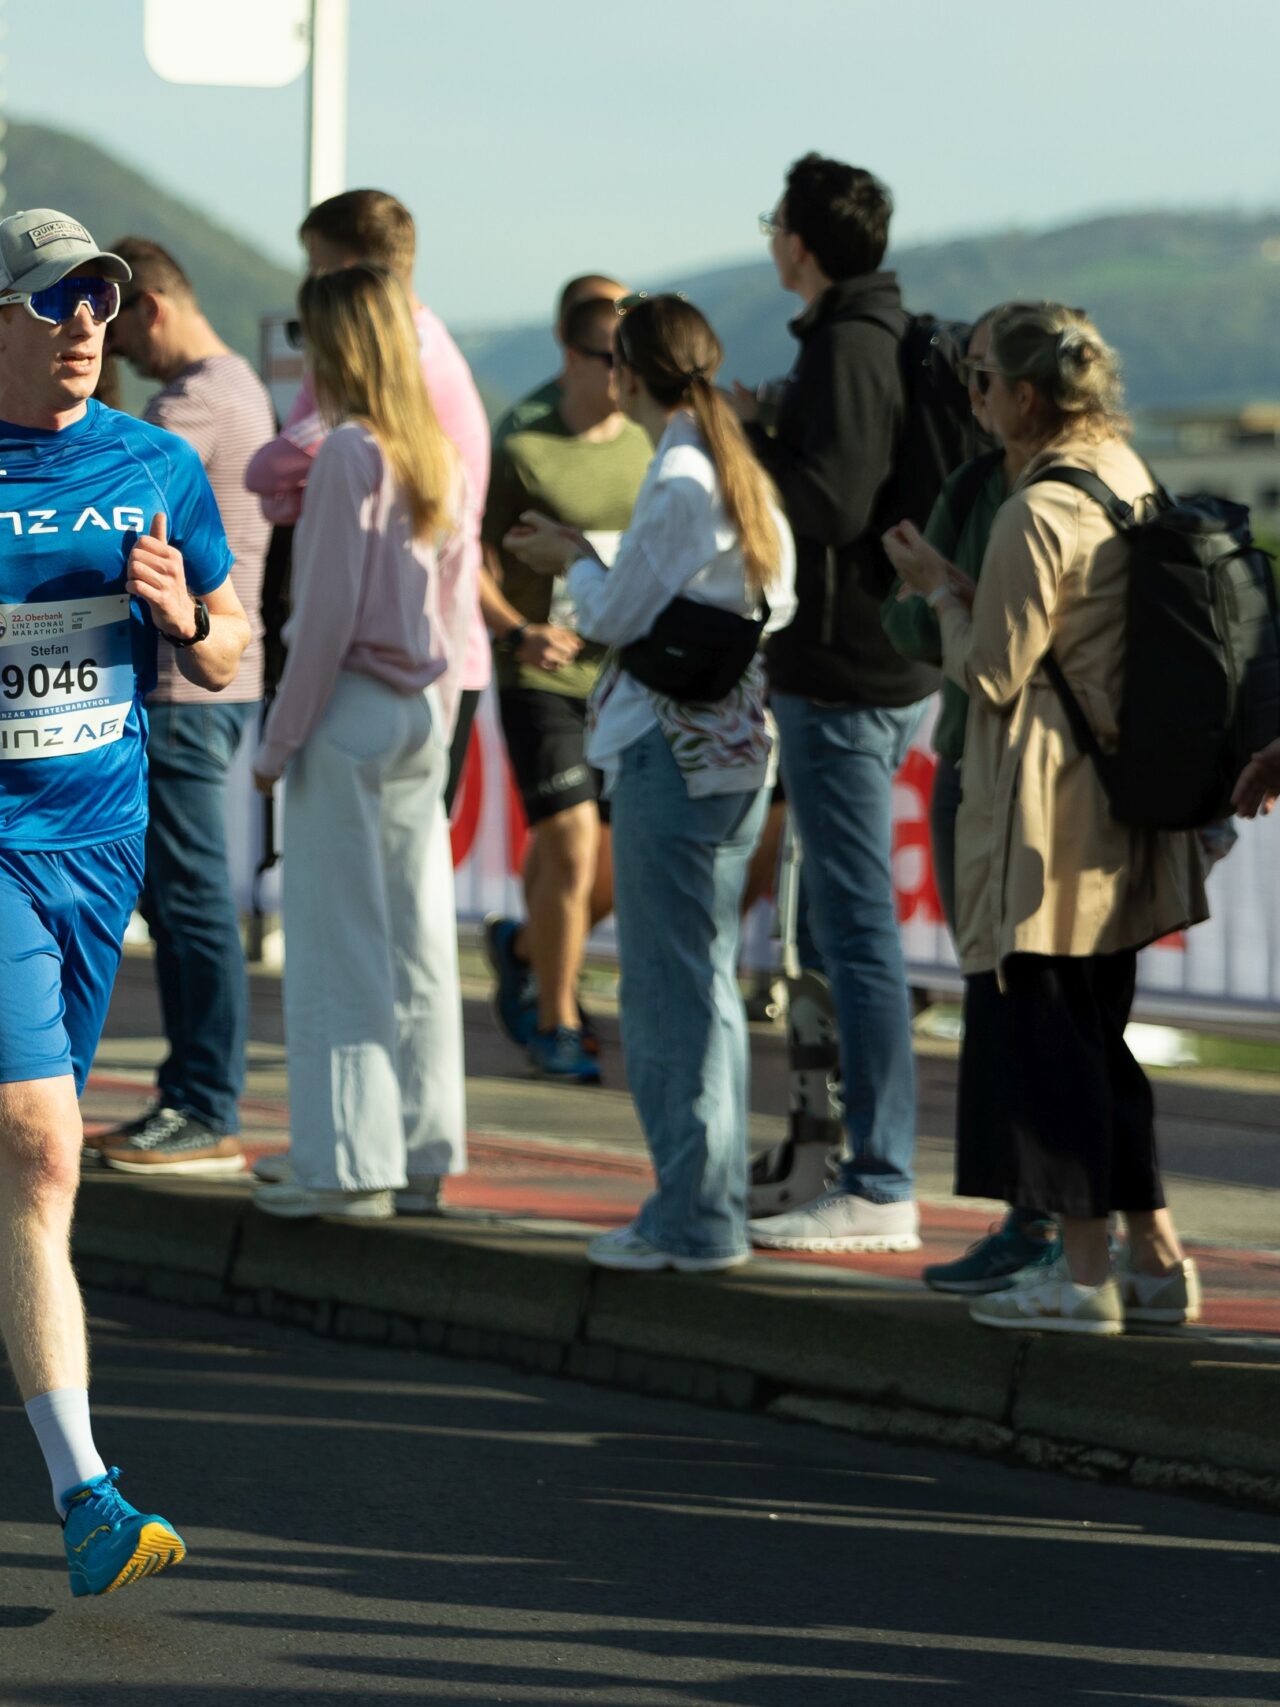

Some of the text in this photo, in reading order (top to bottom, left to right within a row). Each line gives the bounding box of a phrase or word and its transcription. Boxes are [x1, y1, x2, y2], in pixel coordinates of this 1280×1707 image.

[72, 506, 144, 532] AG
[25, 612, 63, 621] Oberbank
[34, 620, 64, 628] DONAU
[12, 628, 65, 636] MARATHON
[30, 644, 69, 657] Stefan
[1, 658, 98, 699] 9046
[29, 699, 111, 716] VIERTELMARATHON
[74, 719, 119, 743] AG
